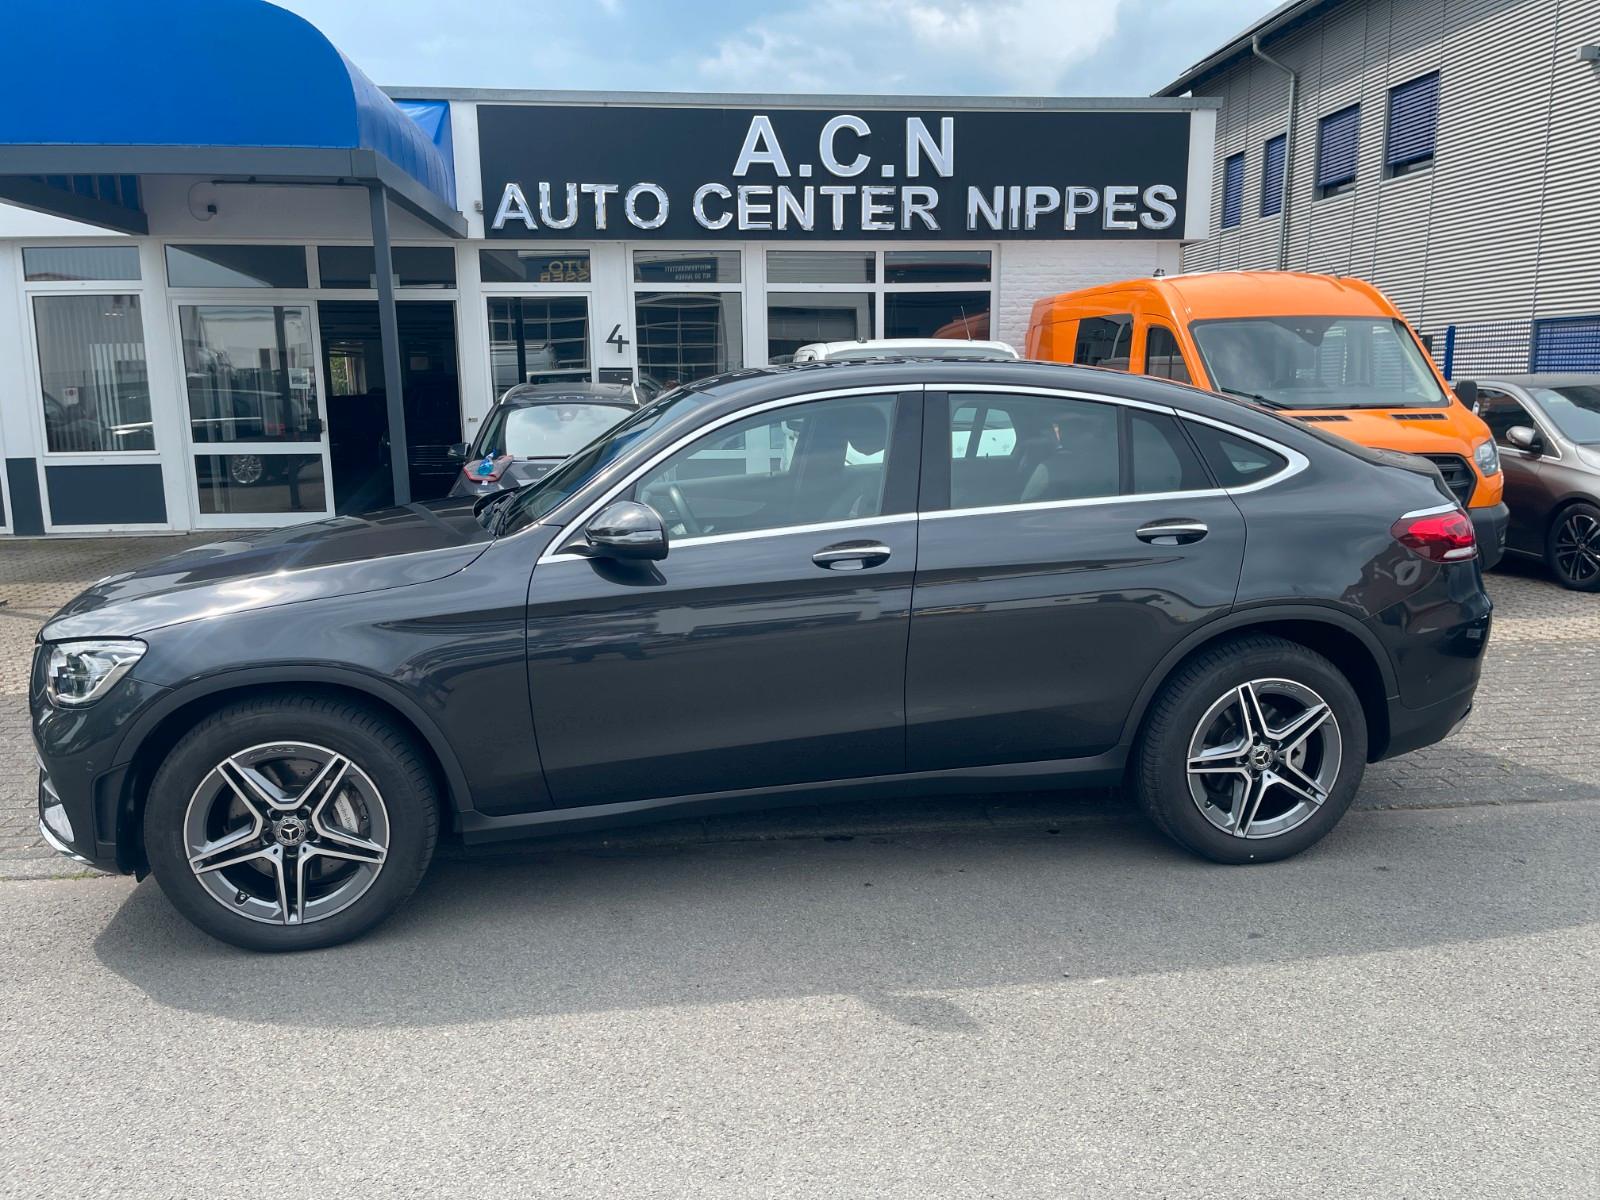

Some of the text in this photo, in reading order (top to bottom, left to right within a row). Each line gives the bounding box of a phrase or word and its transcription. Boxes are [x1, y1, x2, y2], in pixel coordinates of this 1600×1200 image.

[732, 114, 954, 178] A.C.N
[491, 181, 1178, 232] AUTO CENTER NIPPES
[605, 323, 631, 354] 4
